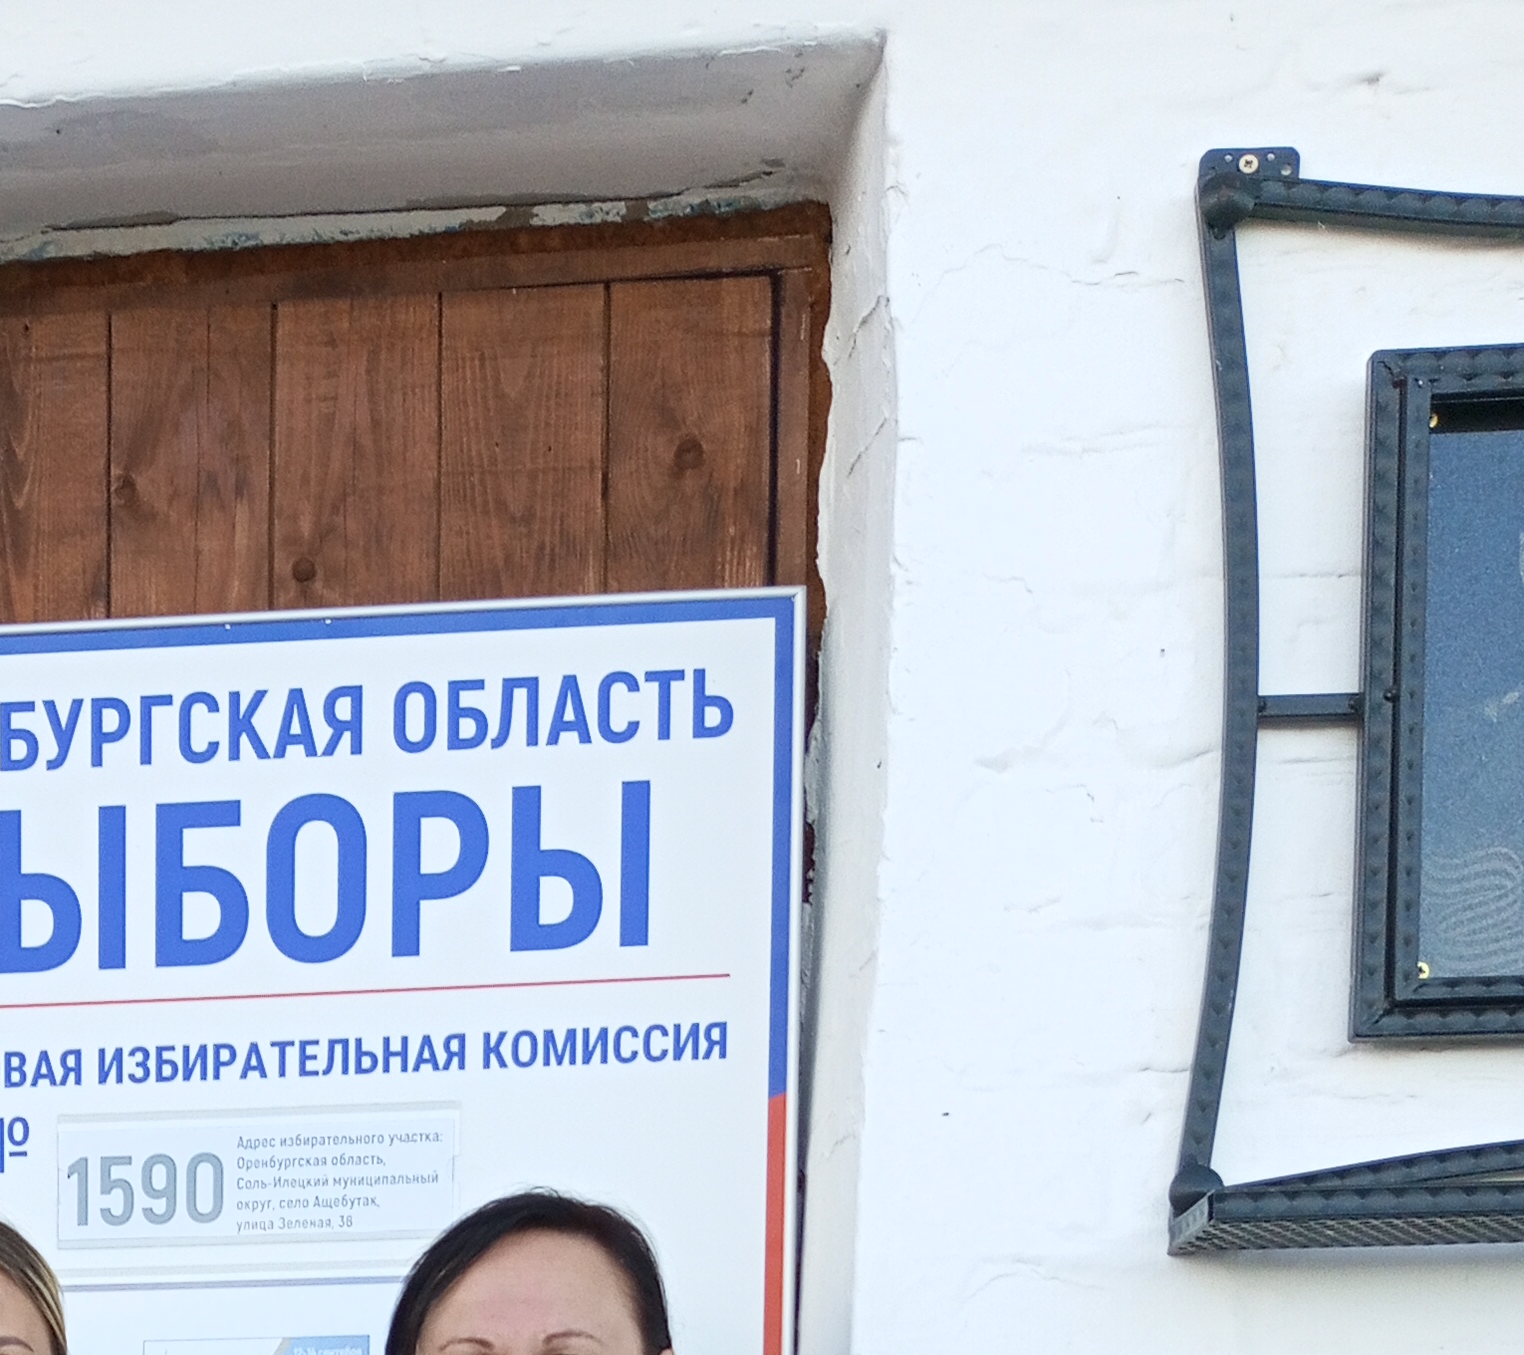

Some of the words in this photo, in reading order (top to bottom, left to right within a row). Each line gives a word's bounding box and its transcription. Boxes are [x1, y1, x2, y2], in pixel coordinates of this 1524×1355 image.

[393, 667, 734, 754] ОБЛАСТЬ
[98, 1032, 466, 1086] ИЗБИРАТЕЛЬНАЯ
[482, 1020, 728, 1070] КОМИССИЯ
[236, 1135, 276, 1151] Адрес
[279, 1133, 385, 1150] избирательного
[388, 1131, 444, 1148] участка:
[236, 1155, 327, 1172] Оренбургская
[331, 1152, 386, 1167] область,
[66, 1151, 225, 1227] 1590
[236, 1173, 329, 1191] Соль-Илецкий
[333, 1170, 439, 1190] муниципальный
[236, 1198, 275, 1213] округ,
[279, 1198, 310, 1210] село
[236, 1217, 274, 1234] улица
